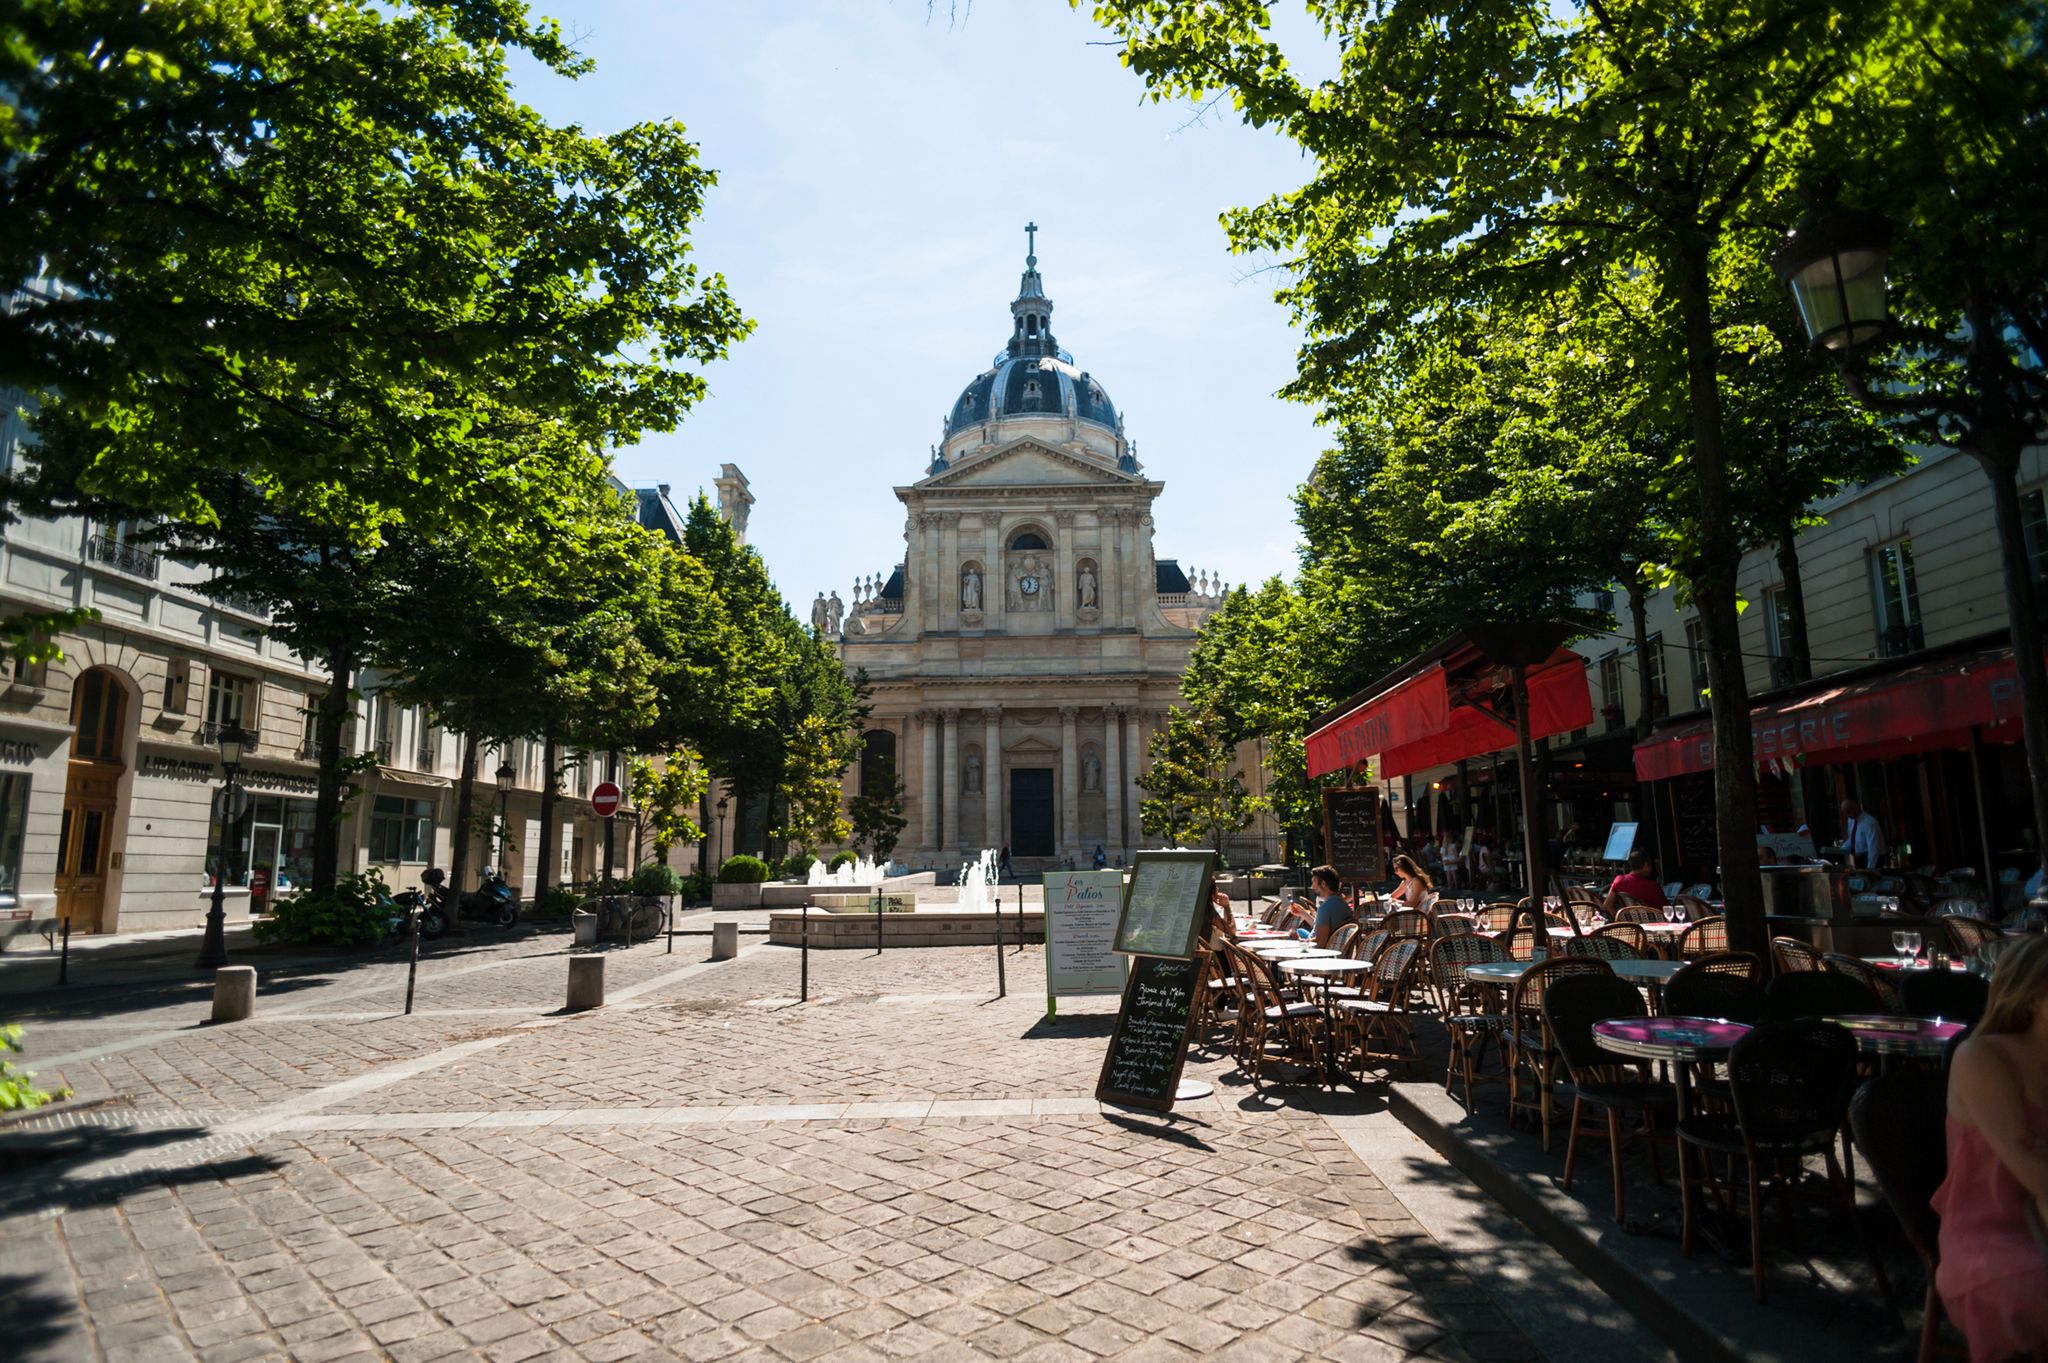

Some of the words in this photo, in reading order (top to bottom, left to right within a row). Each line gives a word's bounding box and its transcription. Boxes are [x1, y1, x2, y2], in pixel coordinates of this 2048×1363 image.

[1699, 712, 1850, 765] BSERIE
[144, 755, 214, 777] LIBRAIRIE
[228, 766, 318, 789] HILOSOPHIQUE
[1067, 885, 1103, 903] Patios
